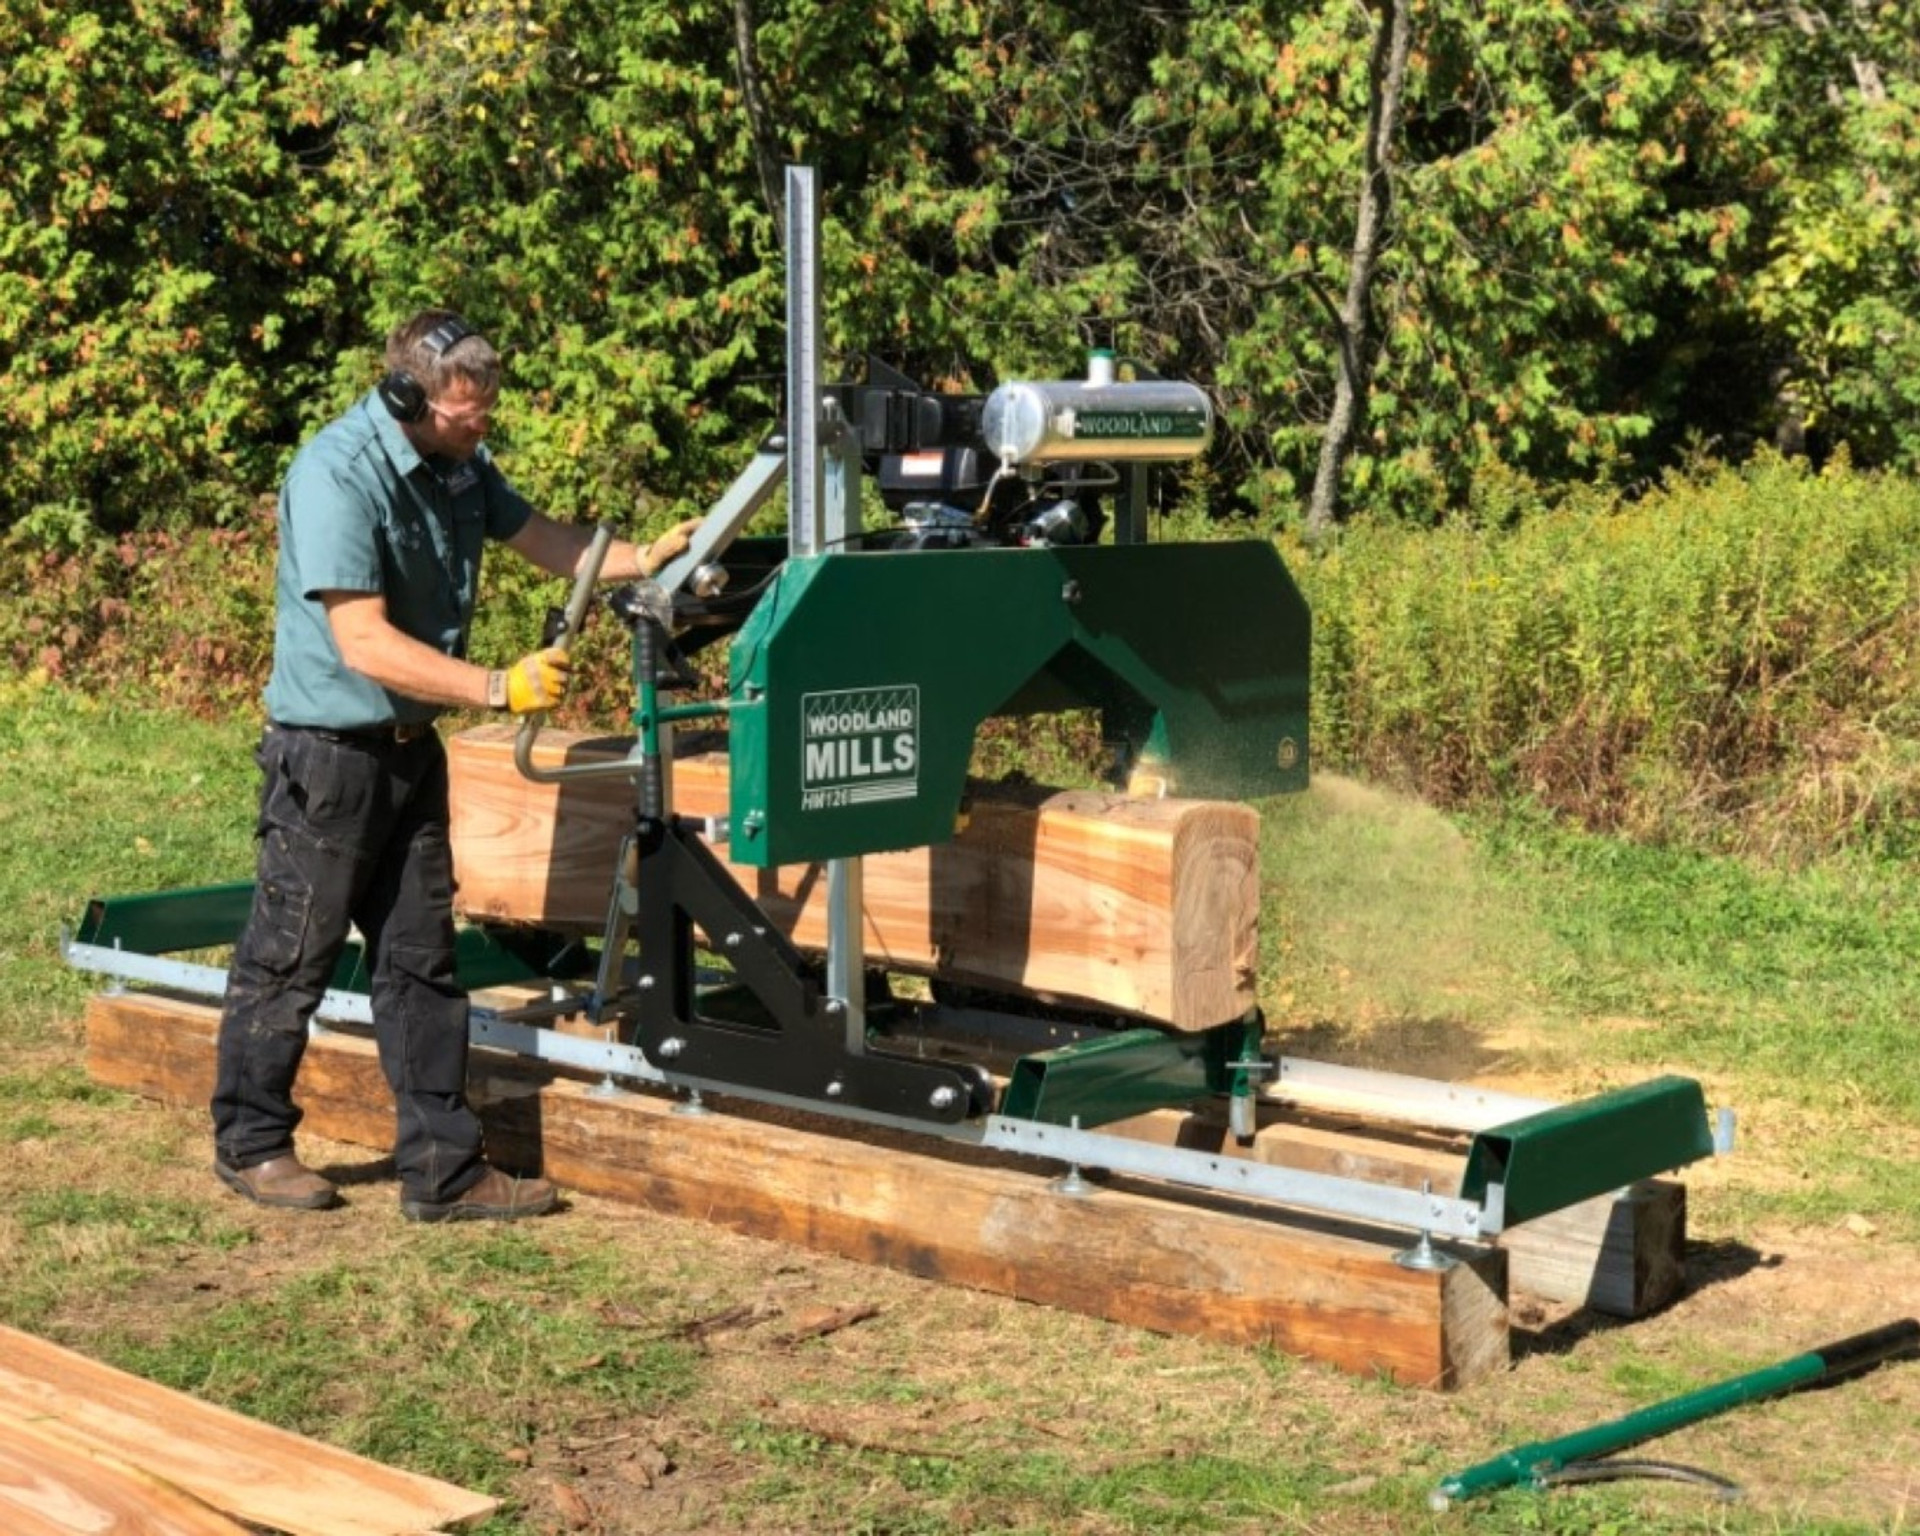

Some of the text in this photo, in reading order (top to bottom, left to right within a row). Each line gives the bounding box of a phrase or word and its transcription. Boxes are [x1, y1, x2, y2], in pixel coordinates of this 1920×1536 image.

[1080, 415, 1172, 433] WOODLAND
[808, 708, 911, 735] WOODLAND
[806, 733, 915, 781] MILLS
